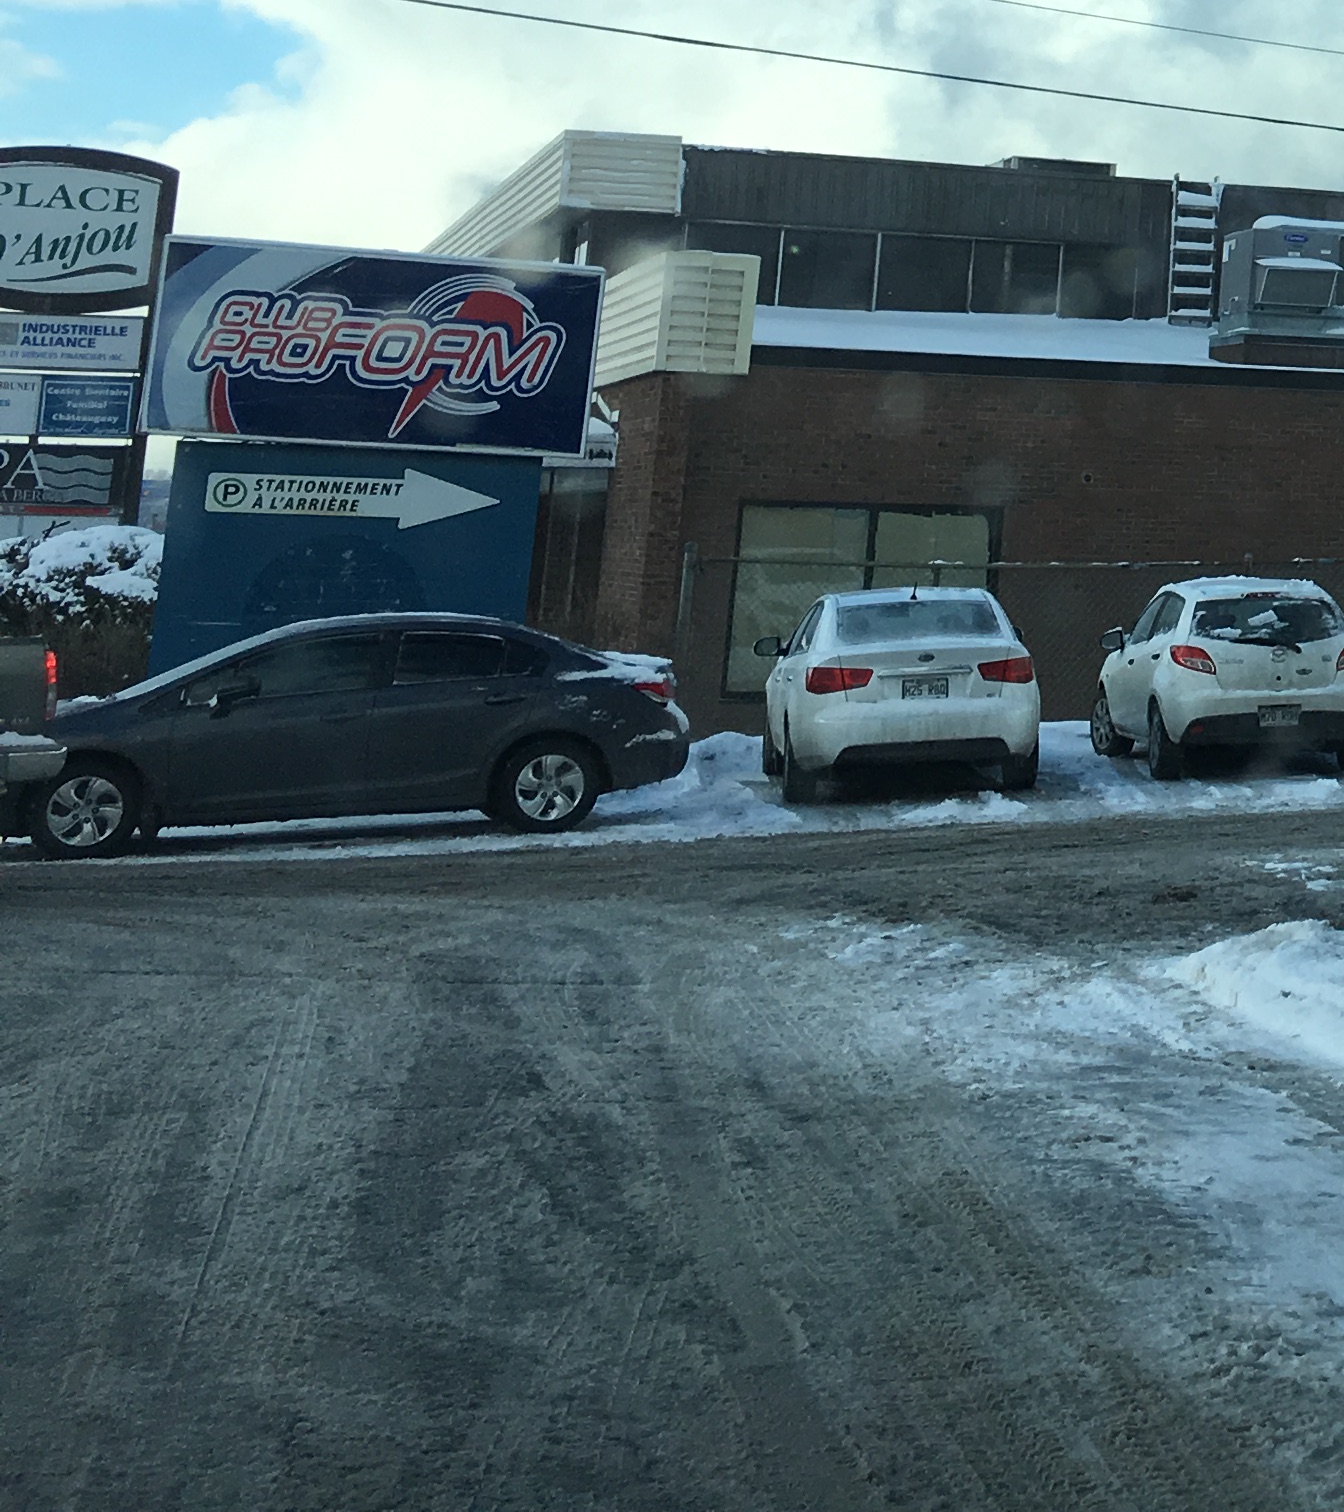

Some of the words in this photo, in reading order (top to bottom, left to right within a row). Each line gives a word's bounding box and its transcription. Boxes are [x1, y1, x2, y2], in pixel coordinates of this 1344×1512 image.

[217, 298, 339, 333] CLUB
[22, 322, 129, 337] INDUSTRIELLE
[20, 335, 97, 349] ALLIANCE
[197, 320, 557, 387] PROFORM
[222, 482, 241, 502] P
[252, 477, 404, 498] STATIONNEMENT
[251, 493, 264, 510] À
[269, 495, 361, 513] L'ARRIÈRE
